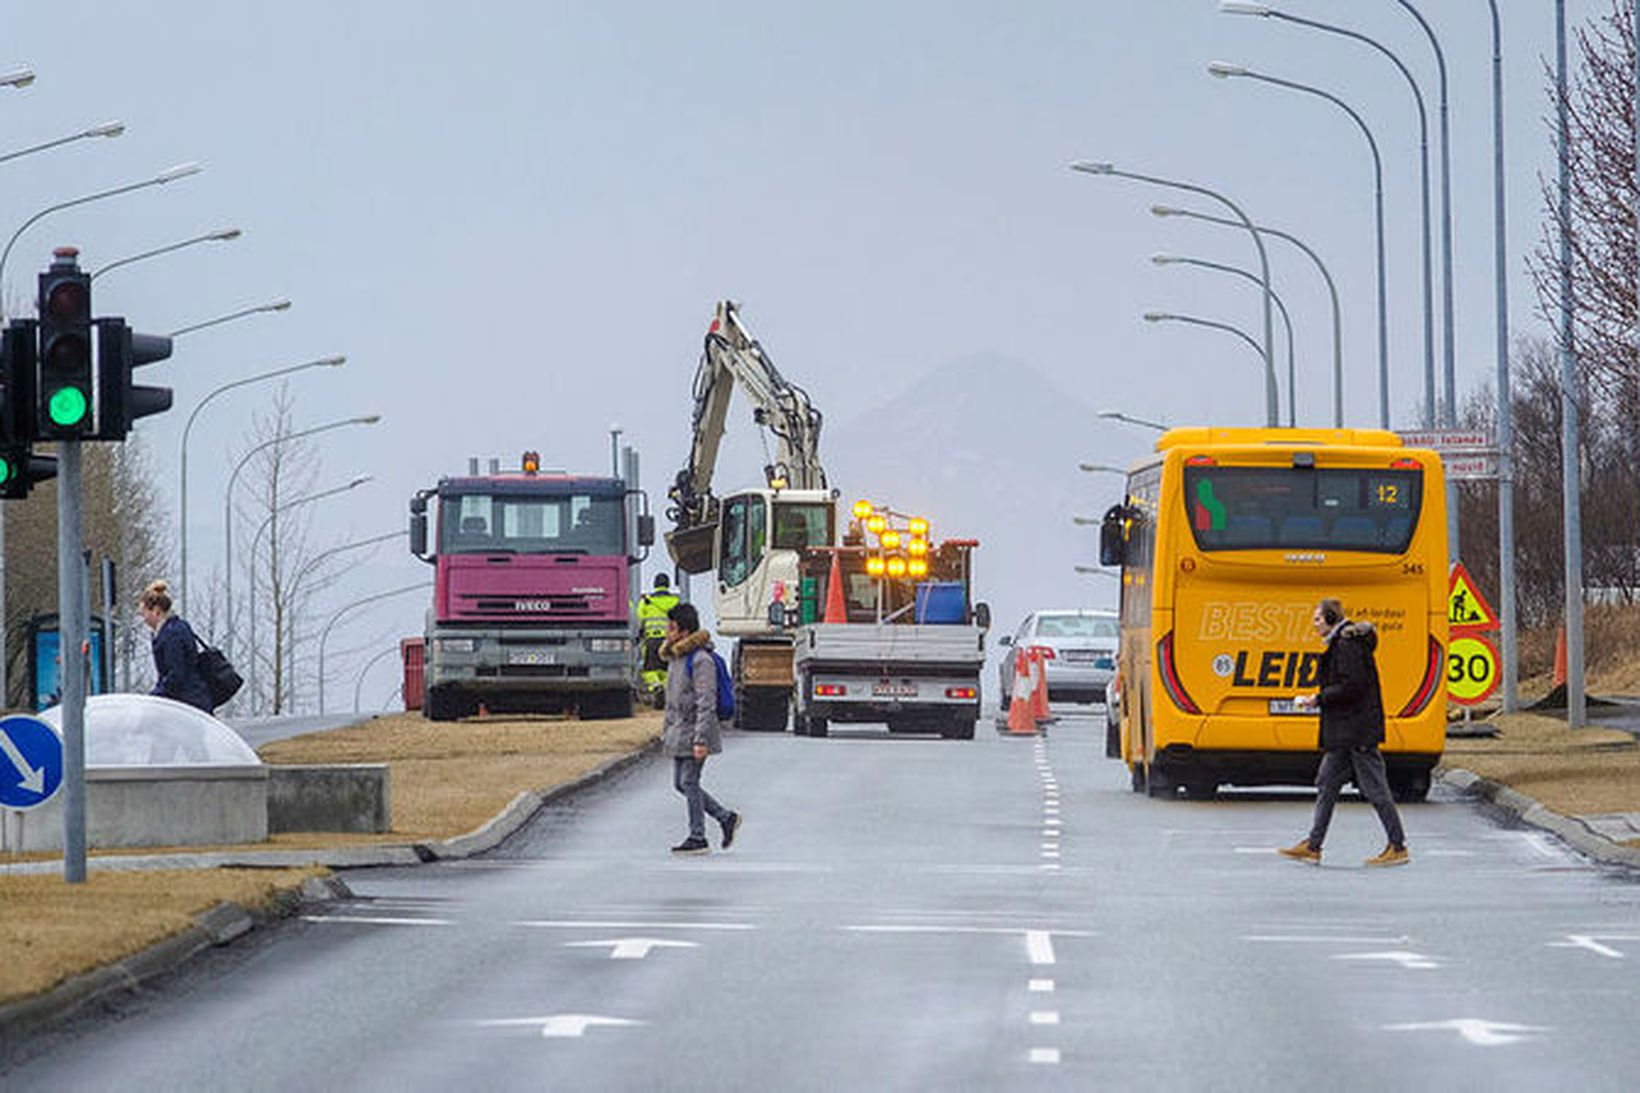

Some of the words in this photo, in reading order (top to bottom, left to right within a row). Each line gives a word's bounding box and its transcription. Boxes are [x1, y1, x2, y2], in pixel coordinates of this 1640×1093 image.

[1377, 485, 1397, 502] 12
[515, 601, 551, 611] IVECO
[1448, 654, 1490, 682] 30
